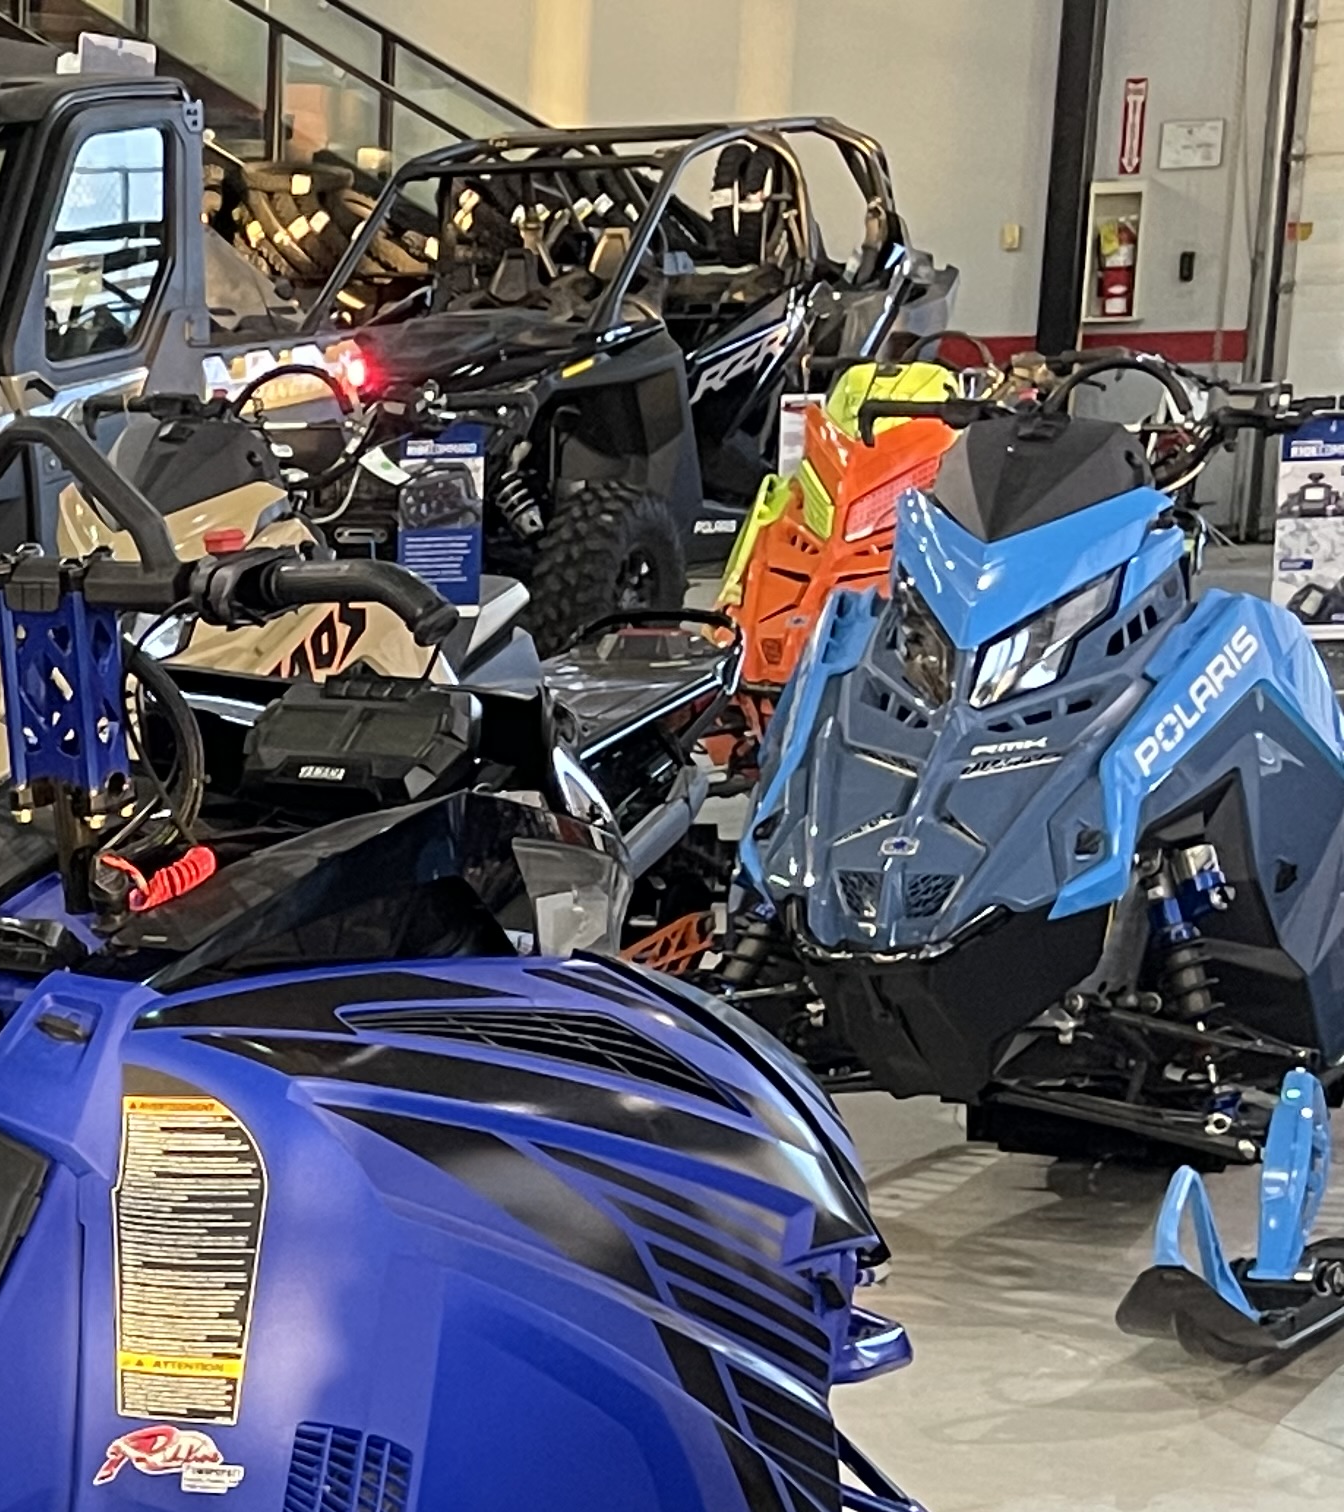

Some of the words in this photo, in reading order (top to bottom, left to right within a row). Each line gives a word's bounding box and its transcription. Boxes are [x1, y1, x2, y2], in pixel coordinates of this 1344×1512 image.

[689, 325, 789, 405] RZR
[1134, 625, 1259, 778] POLARIS
[153, 1360, 225, 1372] ATTENTION
